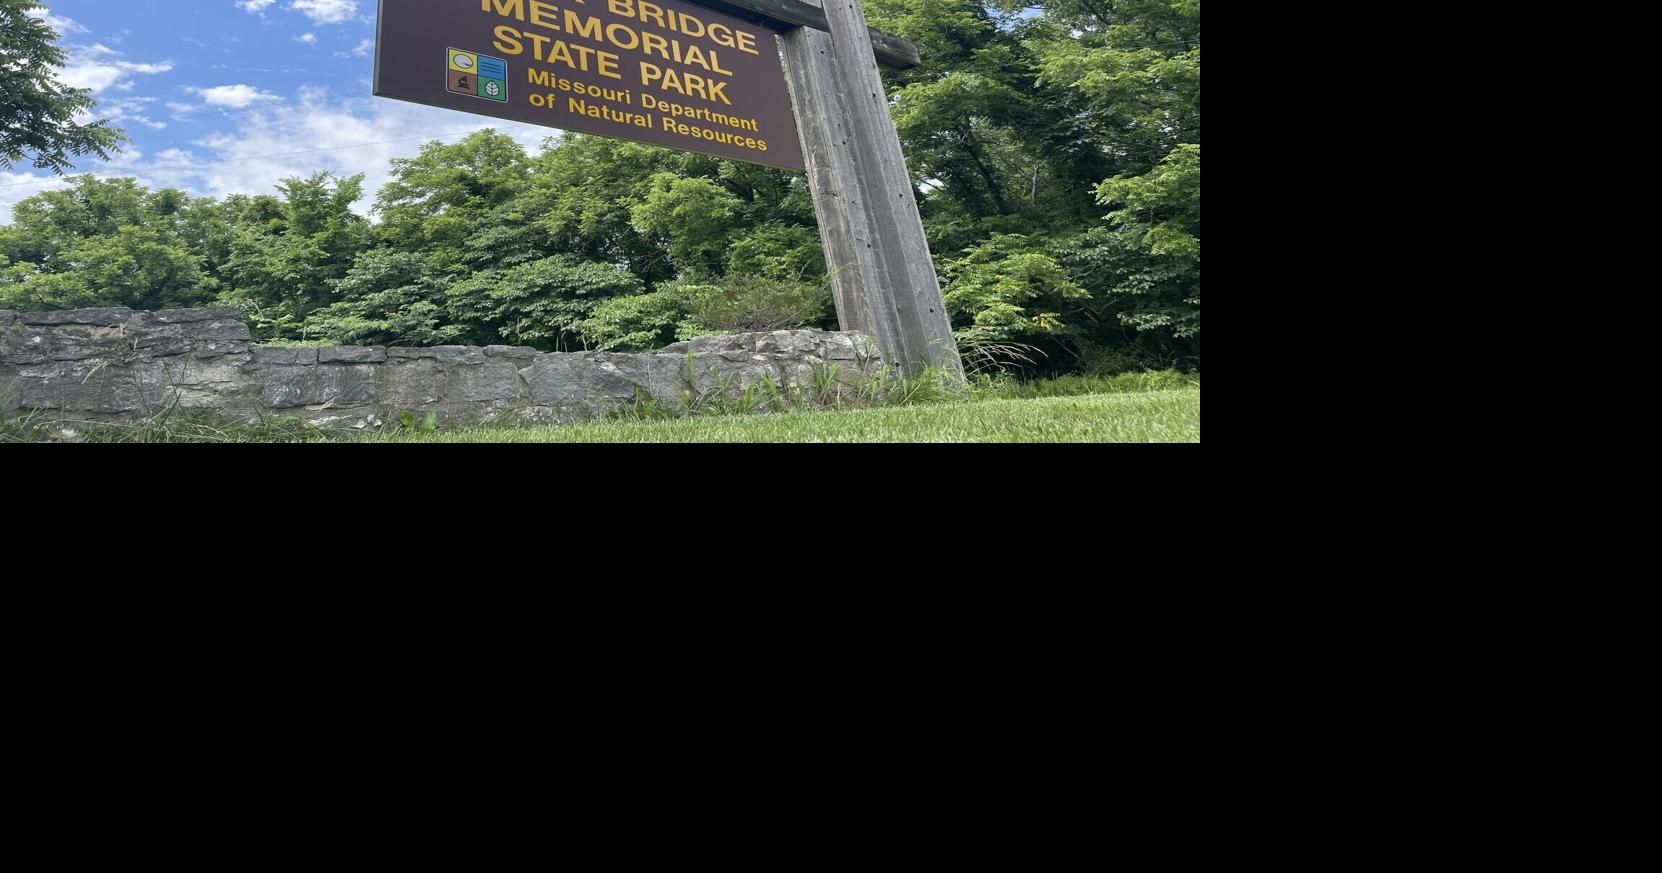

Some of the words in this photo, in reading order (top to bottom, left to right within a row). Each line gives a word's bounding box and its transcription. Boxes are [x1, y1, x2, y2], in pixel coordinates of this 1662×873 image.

[481, 0, 733, 77] MEMORIAL
[607, 0, 759, 55] BRIDGE
[493, 25, 621, 79] STATE
[639, 61, 732, 105] PARK
[527, 67, 632, 105] Missouri
[641, 93, 759, 132] Department
[528, 93, 556, 109] of
[568, 97, 653, 129] Natural
[662, 116, 768, 152] Resources
